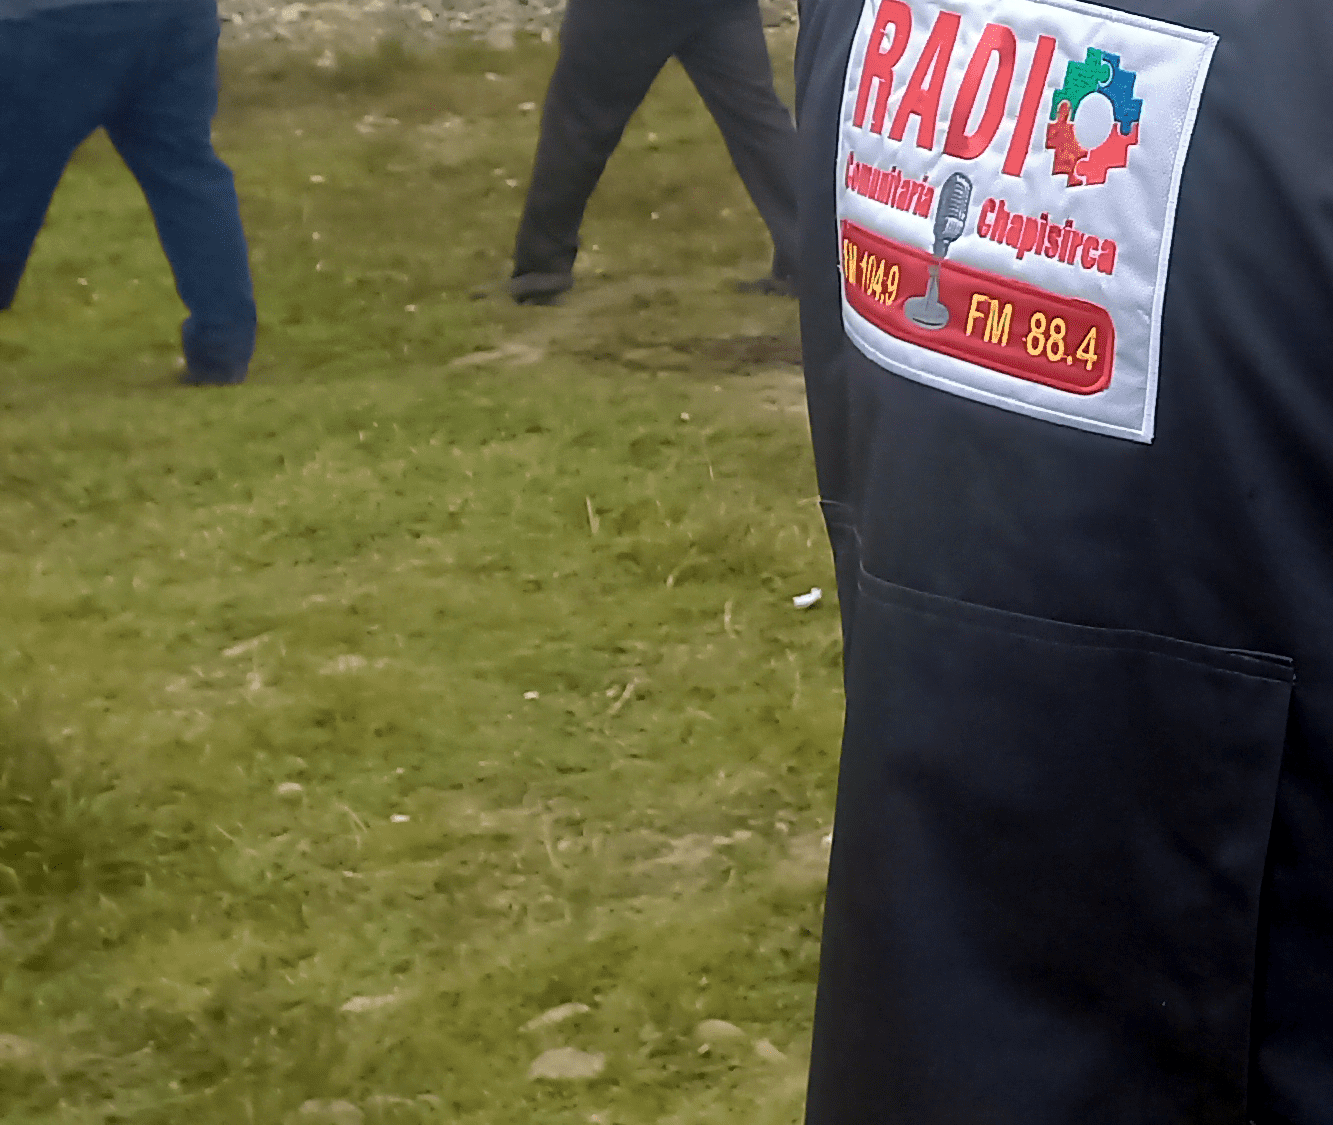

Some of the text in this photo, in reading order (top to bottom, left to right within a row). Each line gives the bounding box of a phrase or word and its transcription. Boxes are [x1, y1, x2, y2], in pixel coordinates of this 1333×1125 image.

[977, 197, 1118, 276] Chapisirca
[966, 293, 1013, 347] FM
[1026, 312, 1098, 370] 88.4
